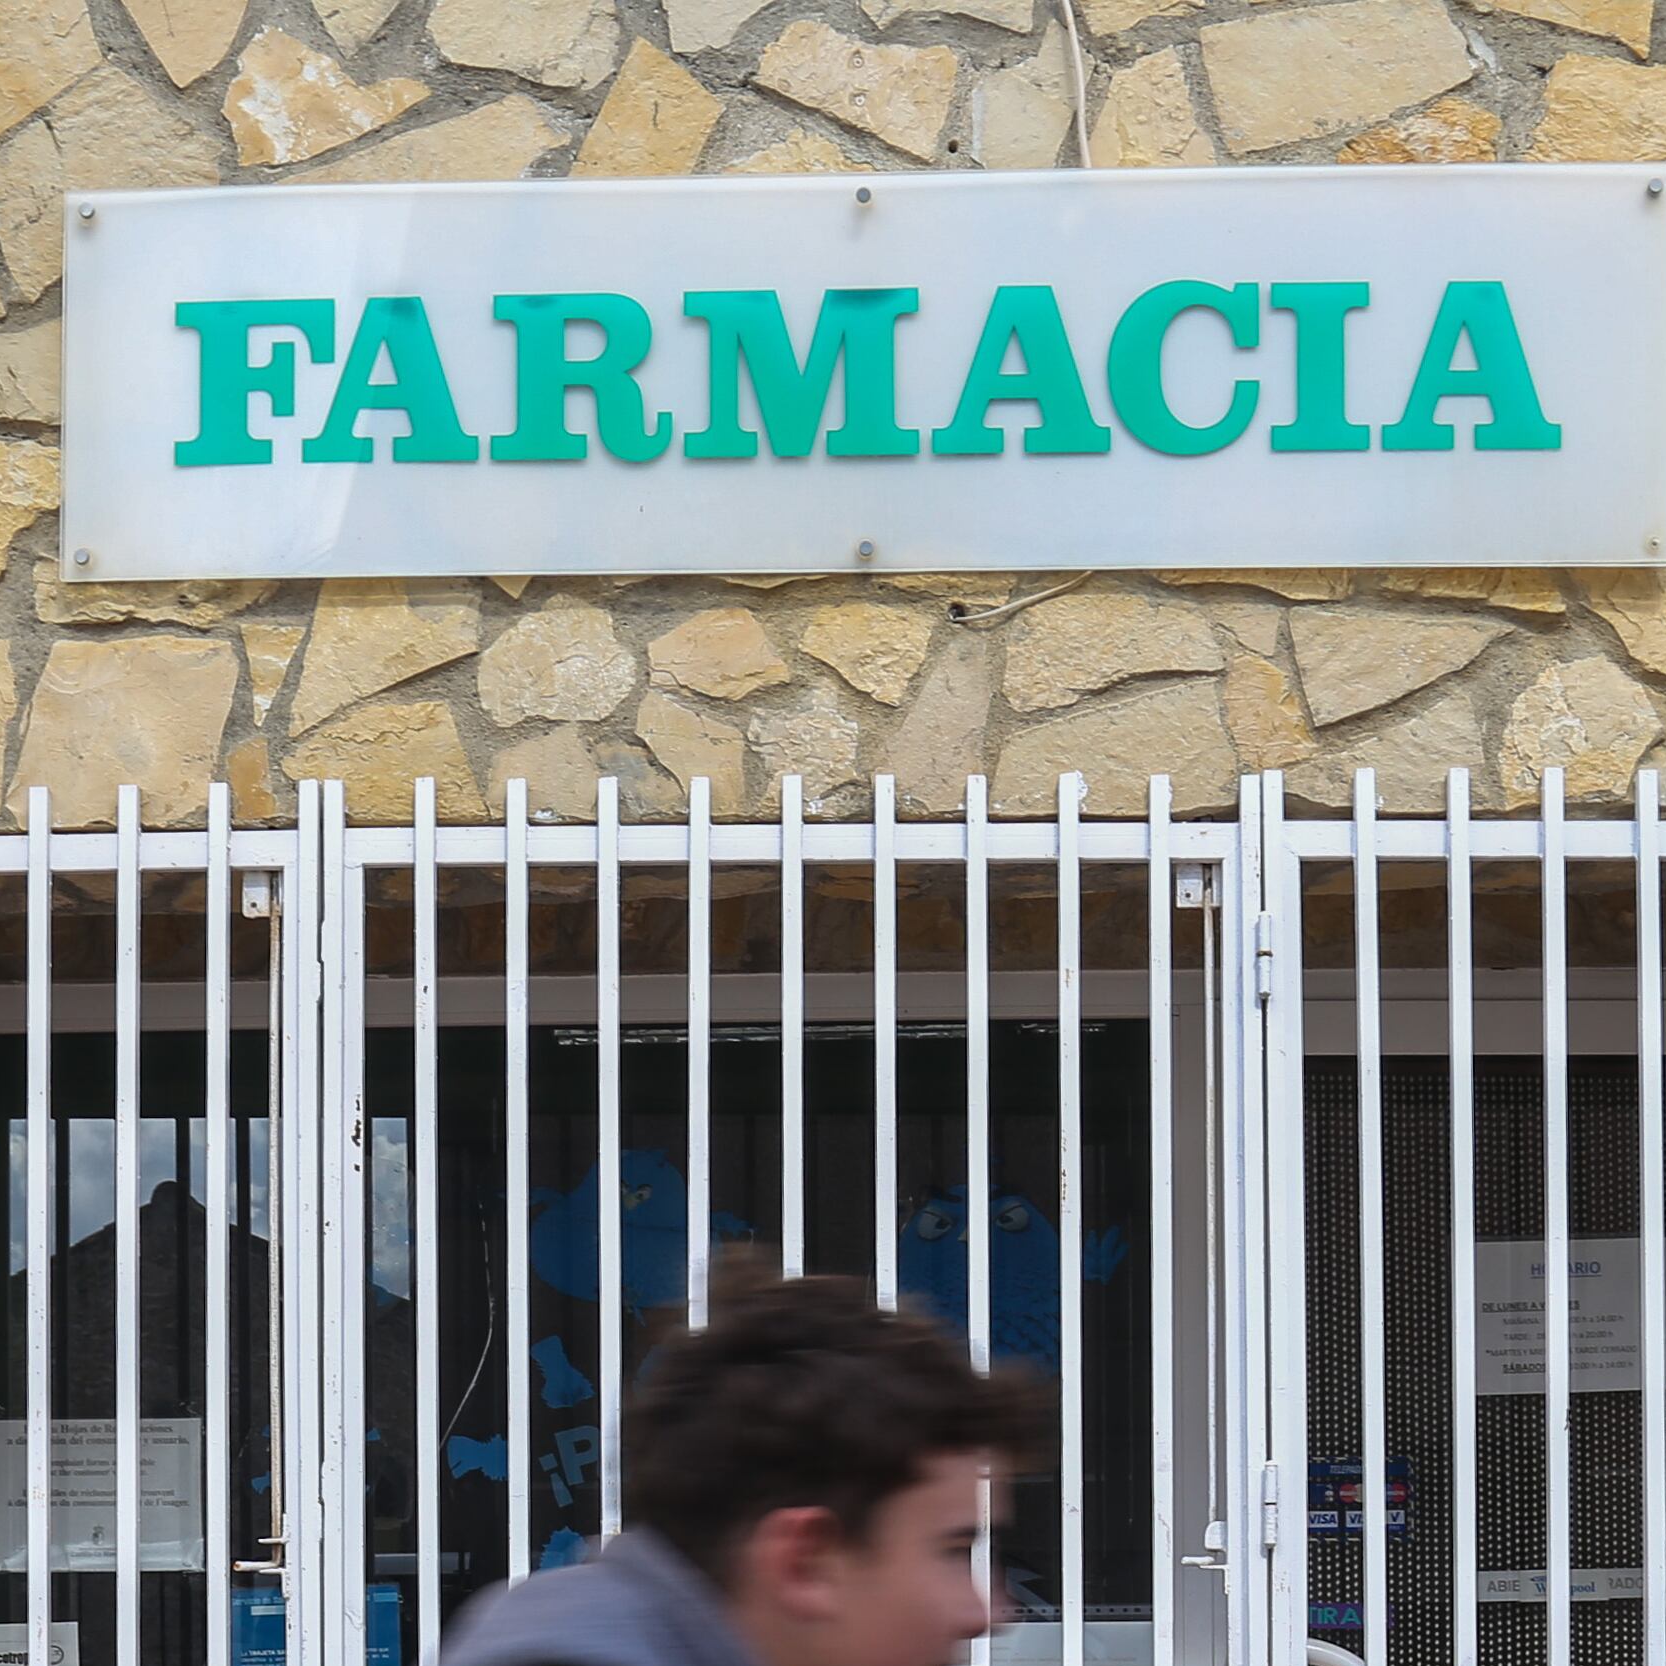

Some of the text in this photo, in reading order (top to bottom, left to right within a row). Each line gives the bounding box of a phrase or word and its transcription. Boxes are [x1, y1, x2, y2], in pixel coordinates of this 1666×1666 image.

[174, 279, 1562, 467] FARMACIA
[1497, 1301, 1527, 1311] LUNES
[1309, 1514, 1337, 1524] VISA
